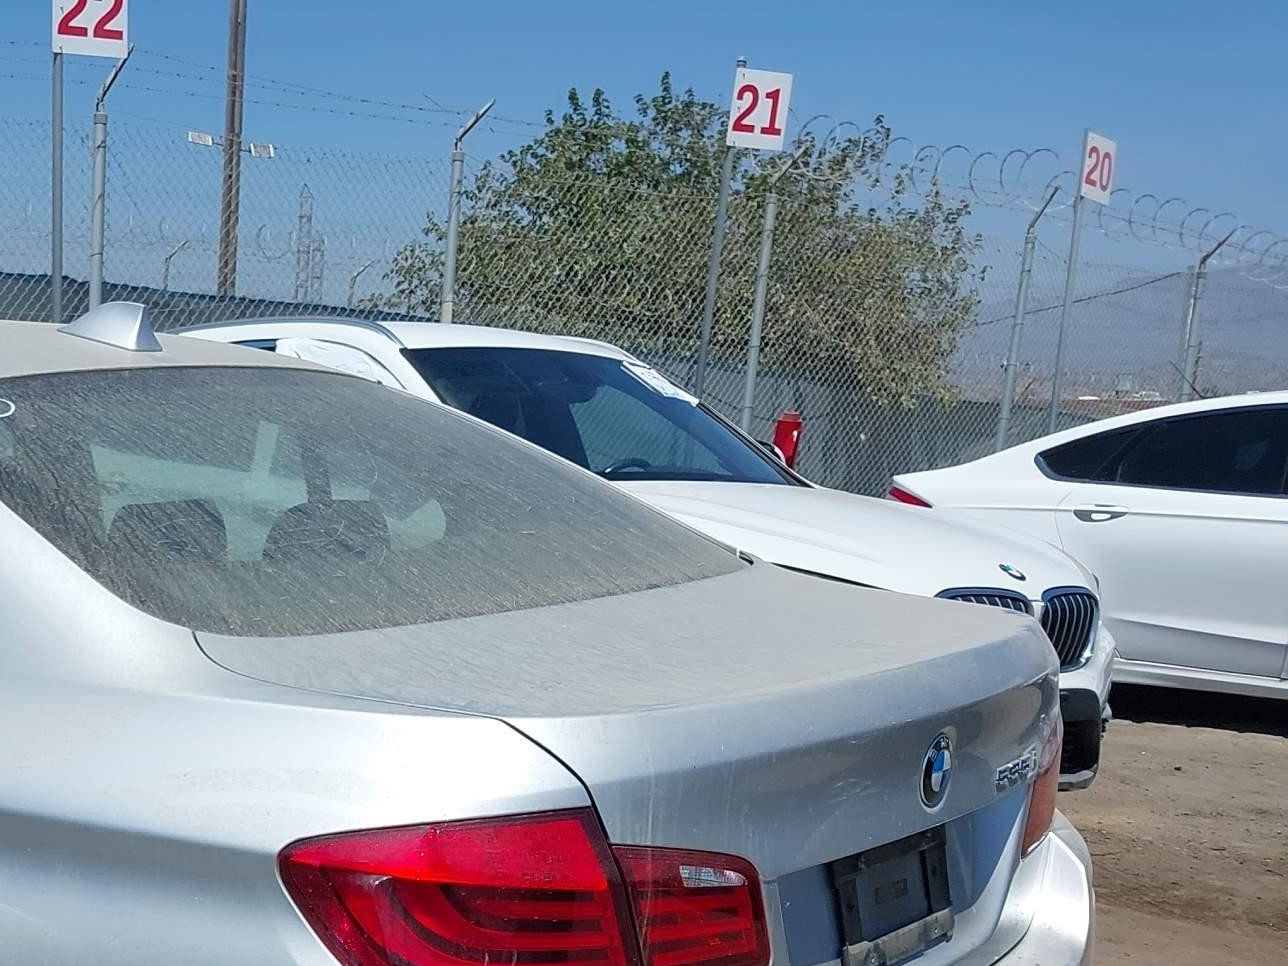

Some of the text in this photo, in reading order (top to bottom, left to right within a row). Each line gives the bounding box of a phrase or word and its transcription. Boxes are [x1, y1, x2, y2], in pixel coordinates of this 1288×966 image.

[57, 0, 123, 41] 22
[732, 84, 782, 136] 21
[1084, 145, 1113, 192] 20
